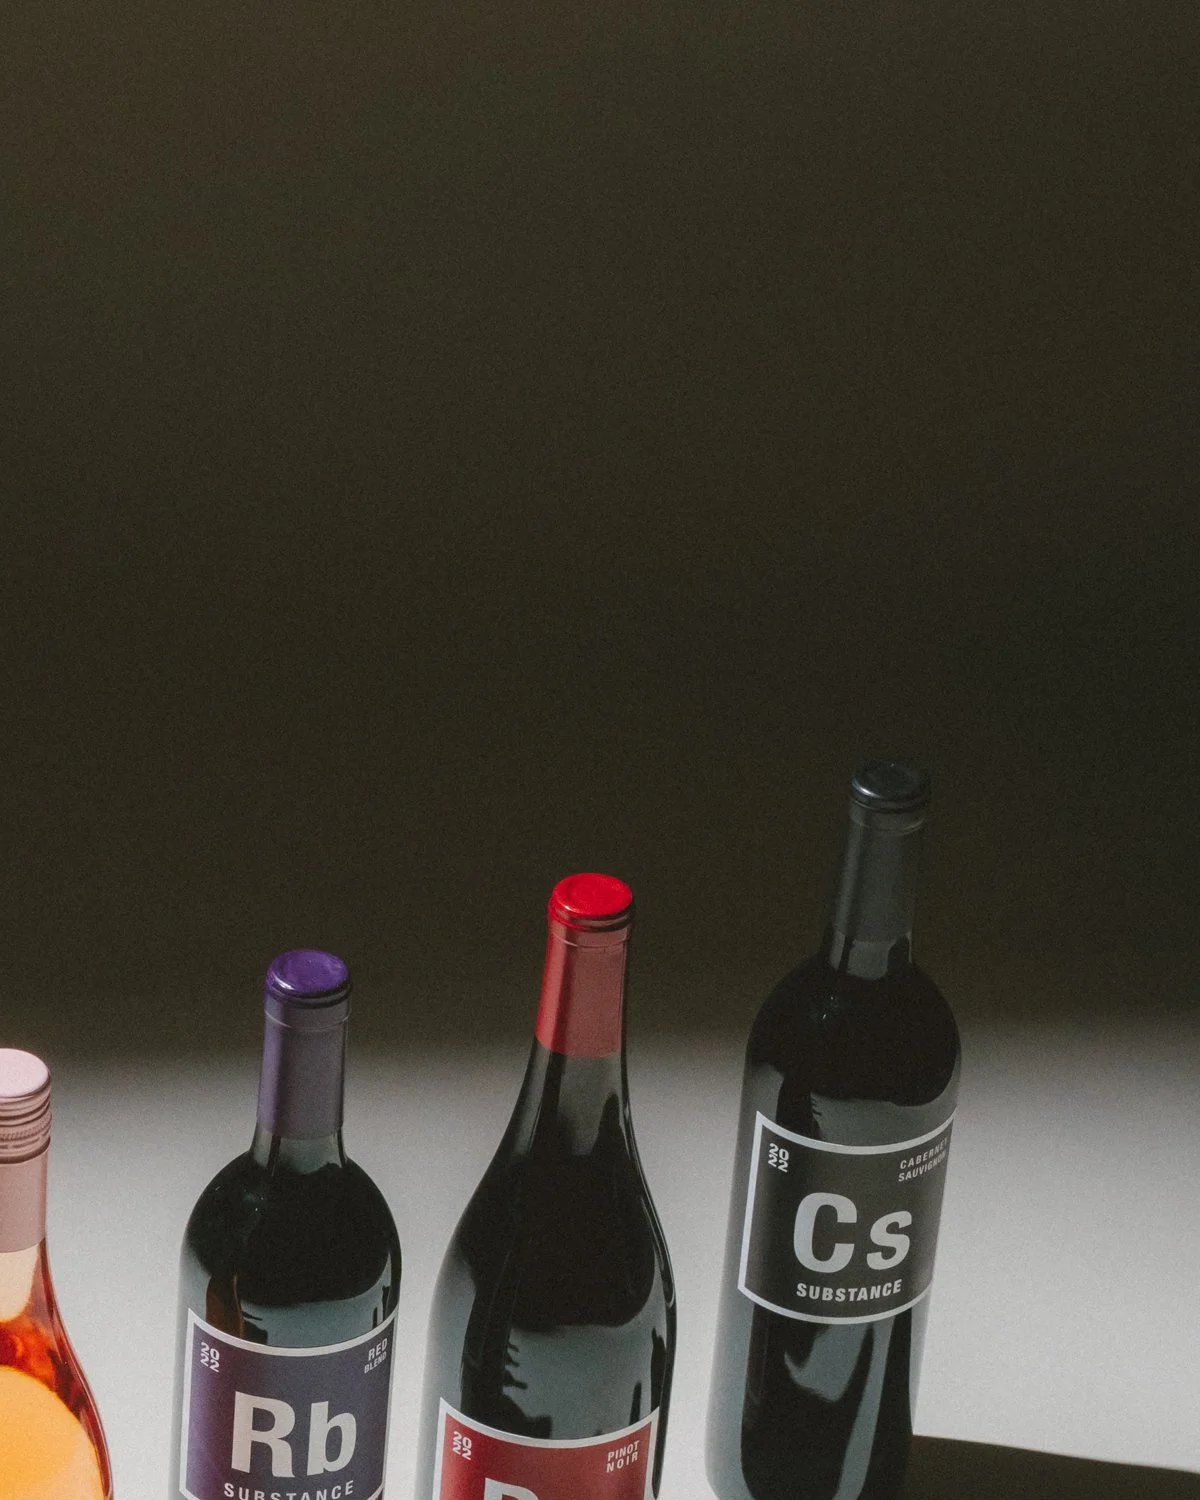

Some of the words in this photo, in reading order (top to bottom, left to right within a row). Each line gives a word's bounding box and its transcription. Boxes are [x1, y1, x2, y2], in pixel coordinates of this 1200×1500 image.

[767, 1153, 788, 1173] 22
[769, 1143, 790, 1161] 20
[793, 1192, 913, 1273] Cs
[796, 1279, 903, 1302] SUBSTANCE
[201, 1342, 220, 1361] 20
[368, 1338, 388, 1361] RED
[200, 1352, 220, 1373] 22
[364, 1351, 387, 1374] BLEND
[231, 1391, 357, 1478] Rb
[452, 1431, 472, 1449] 20
[452, 1442, 472, 1461] 22
[606, 1451, 639, 1473] NOIR
[607, 1440, 640, 1462] PINOT
